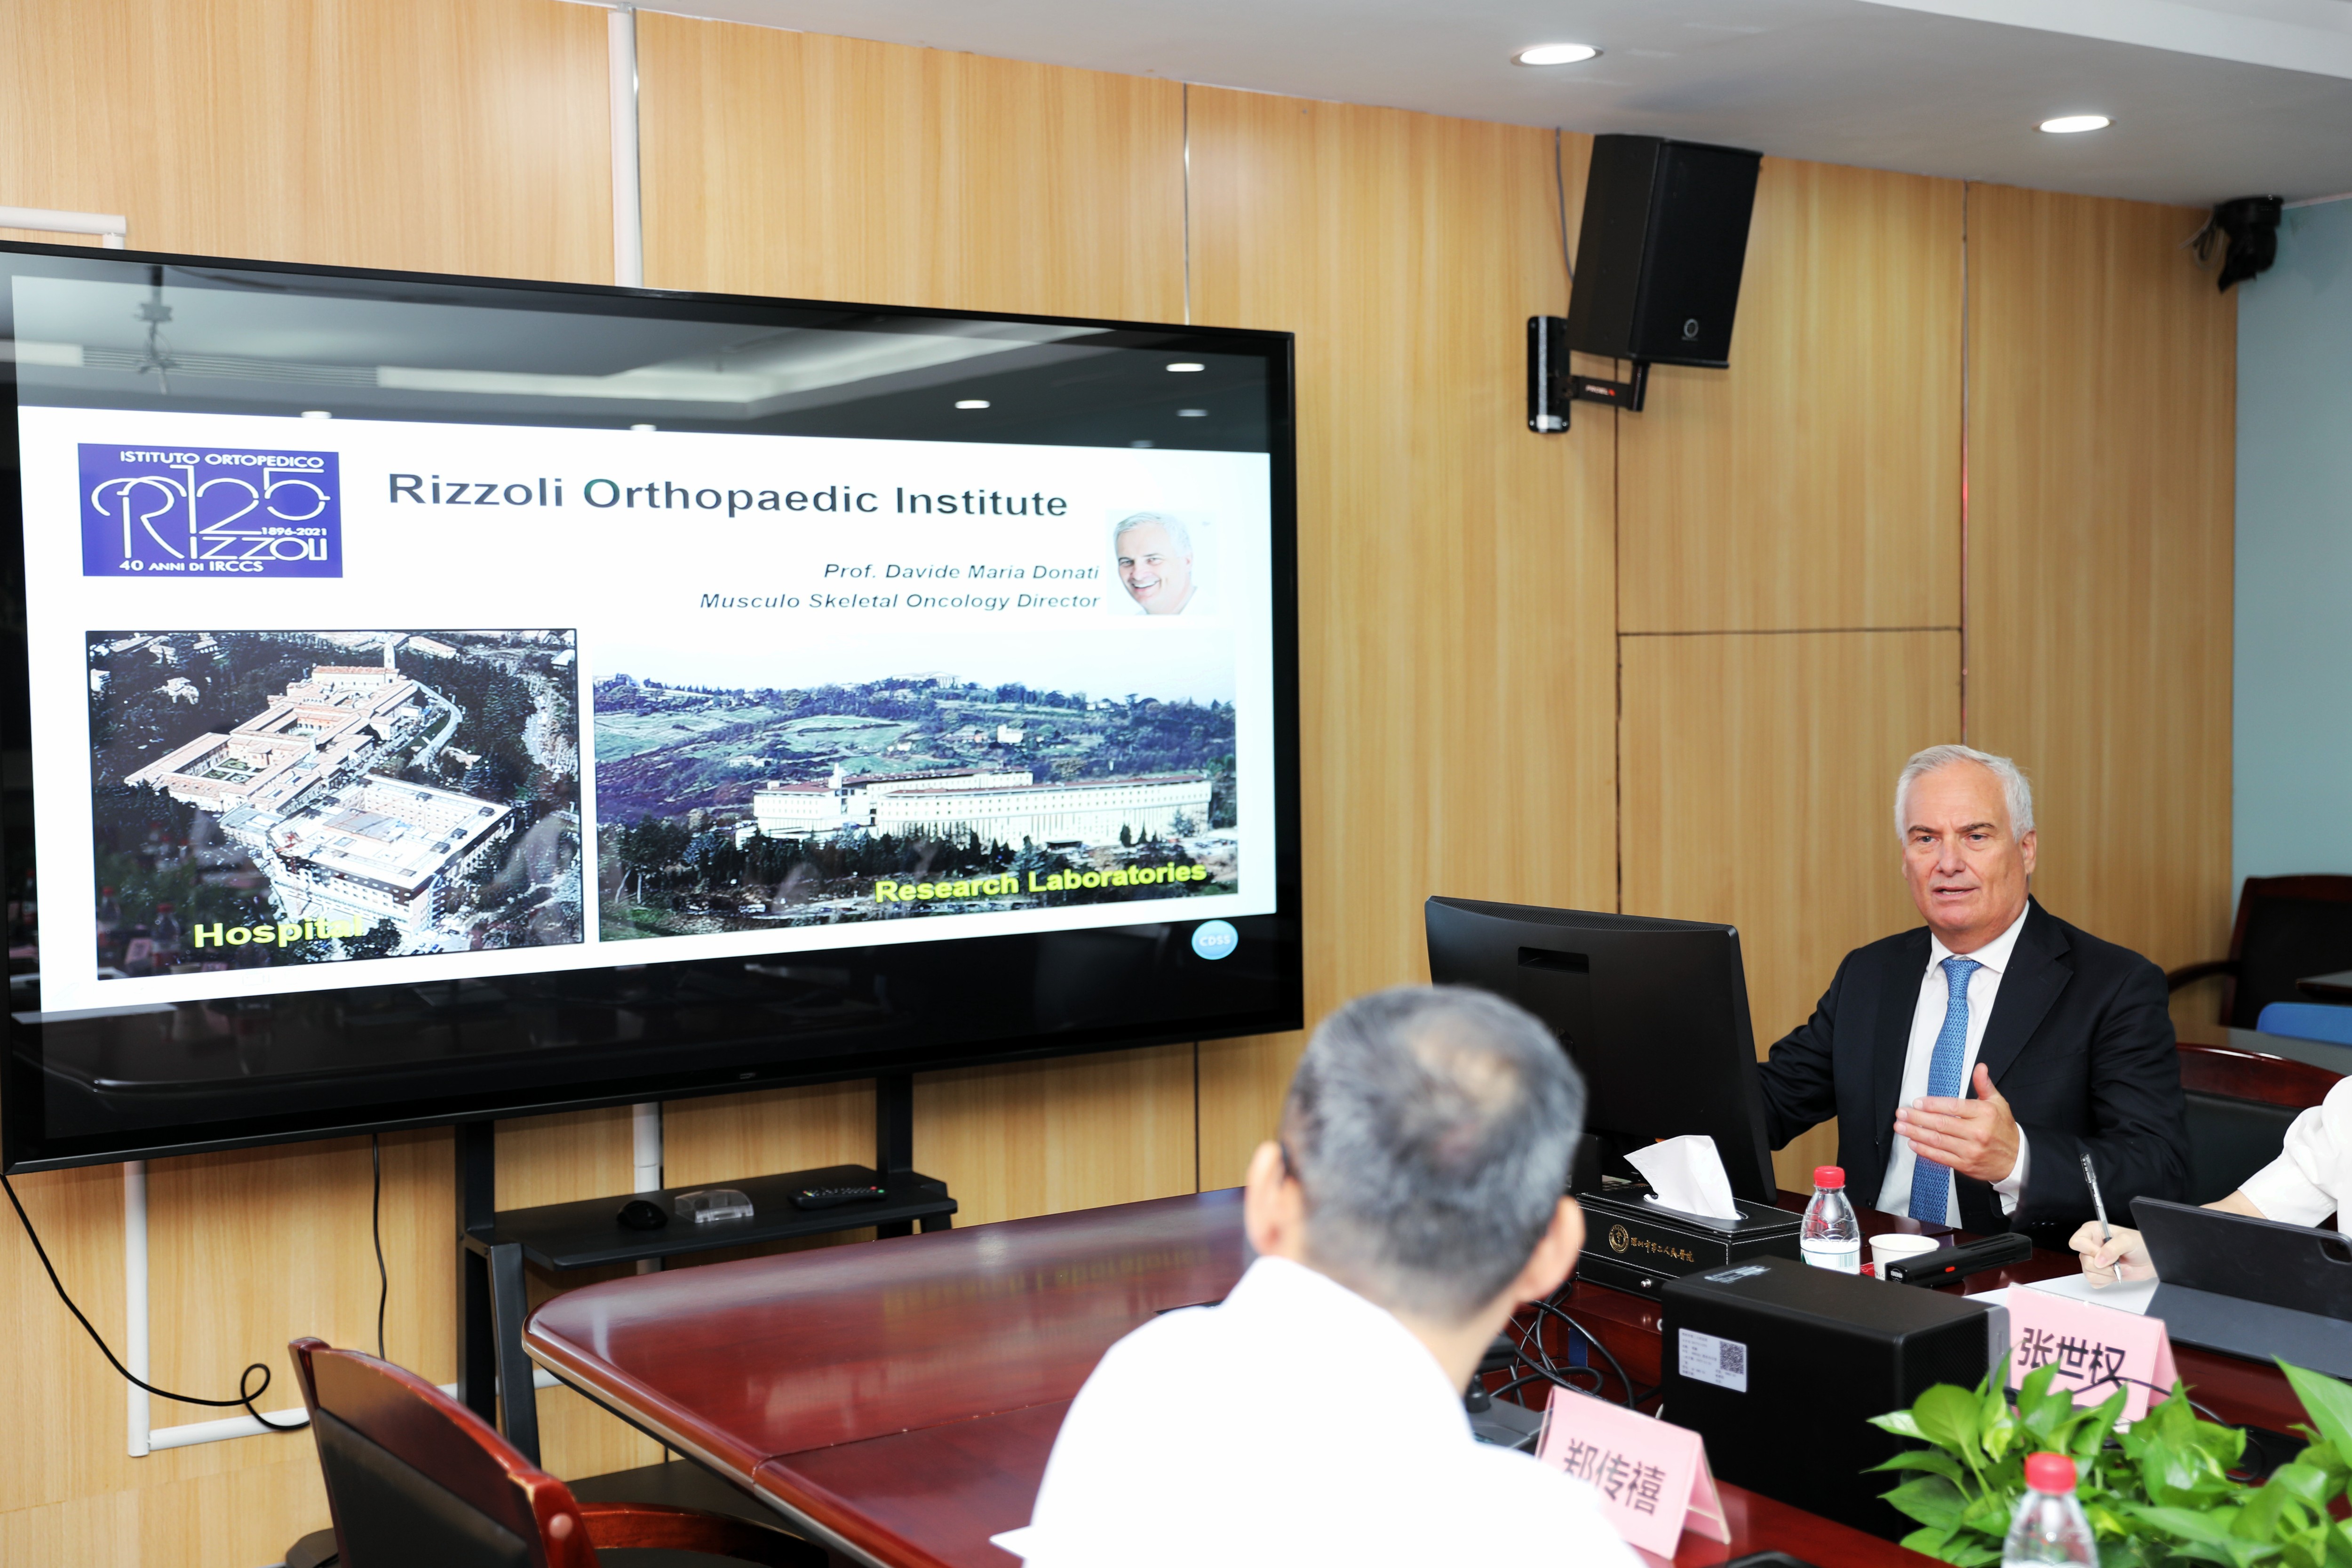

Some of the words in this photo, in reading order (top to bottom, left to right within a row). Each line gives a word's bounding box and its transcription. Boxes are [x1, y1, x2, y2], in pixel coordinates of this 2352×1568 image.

[120, 450, 200, 464] ISTITUTO
[204, 453, 325, 468] ORTOPEDICO
[389, 473, 563, 507] Rizzoli
[583, 478, 879, 518] Orthopaedic
[896, 487, 1067, 517] Institute
[261, 526, 327, 536] 1896-2021
[119, 560, 144, 572] 40
[148, 562, 185, 572] ANNI
[189, 562, 204, 572] DI
[209, 560, 264, 573] IRCCS
[824, 564, 876, 579] Prof.
[885, 564, 961, 579] Davide
[968, 565, 1025, 580] Maria
[1032, 565, 1100, 580] Donati
[700, 593, 800, 609] Musculo
[809, 593, 898, 608] Skeletal
[906, 593, 1010, 611] Oncology
[1017, 594, 1101, 608] Director
[875, 872, 1019, 903] Research
[1028, 861, 1208, 893] Laboratories
[194, 914, 363, 948] Hospital
[2018, 1327, 2126, 1390] 张世权
[1563, 1438, 1666, 1516] 郑传禧
